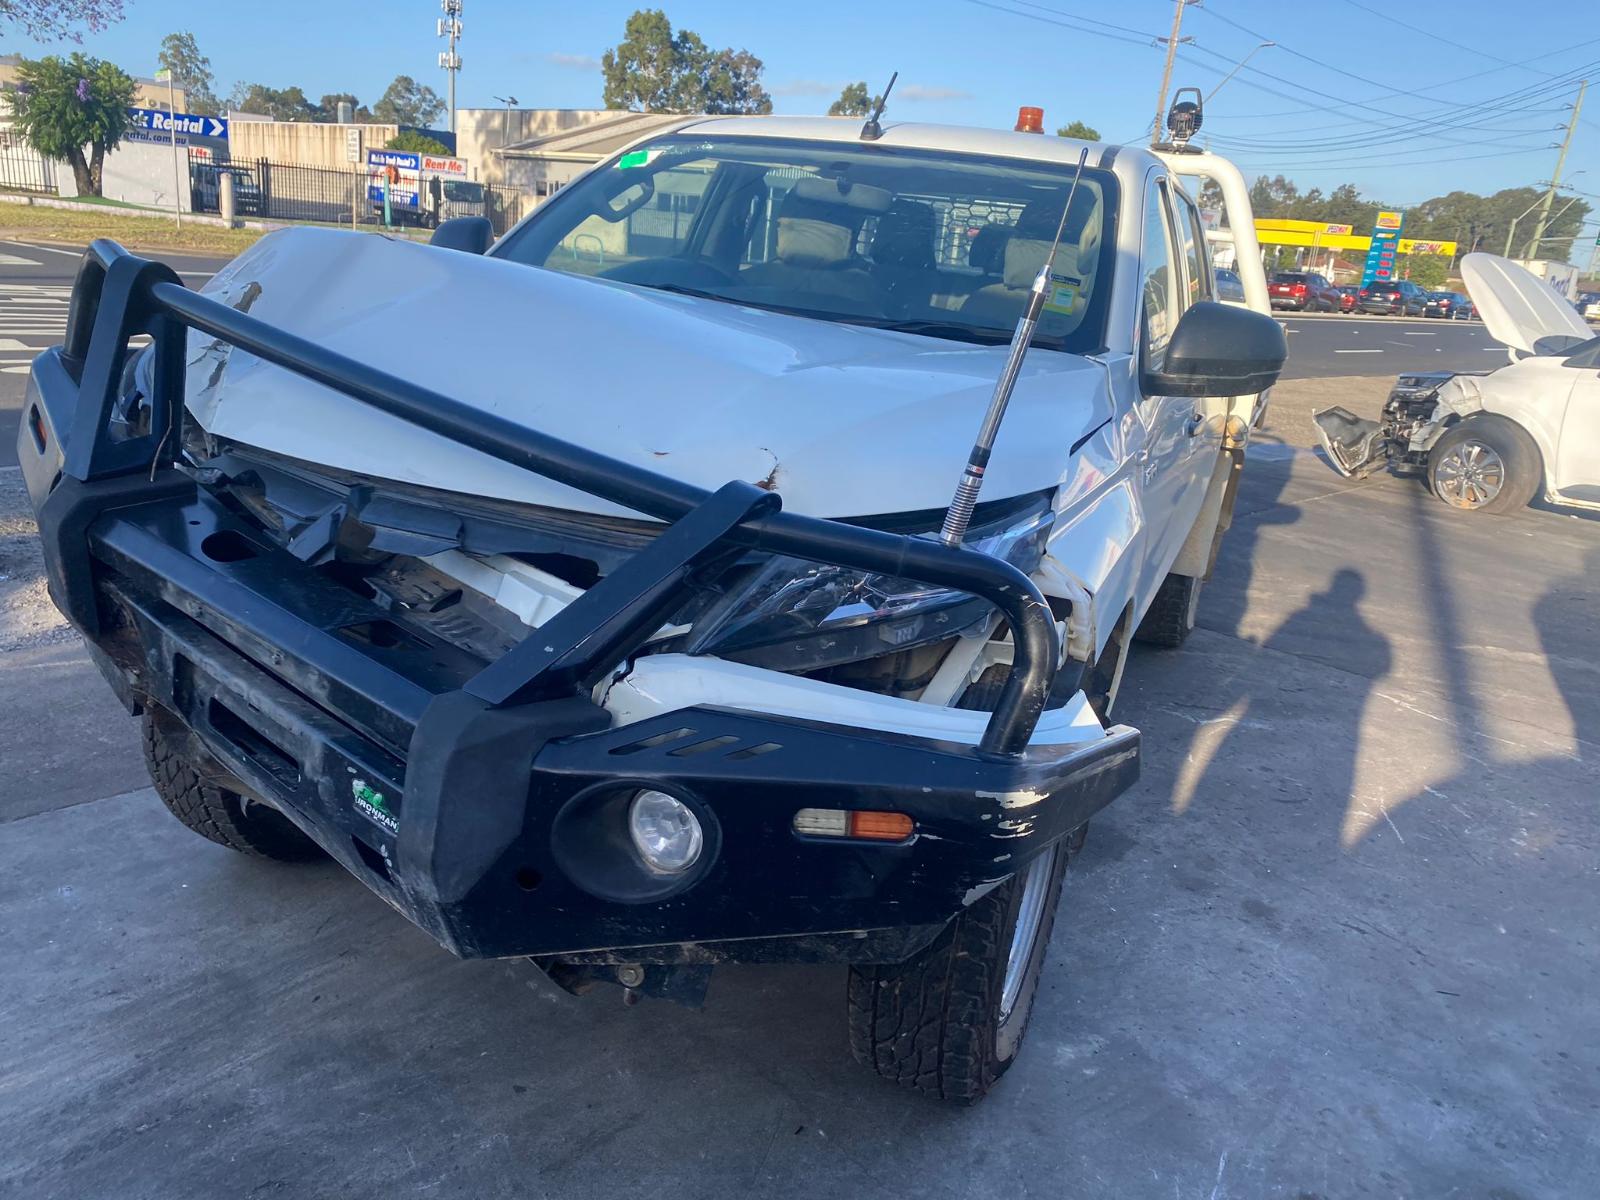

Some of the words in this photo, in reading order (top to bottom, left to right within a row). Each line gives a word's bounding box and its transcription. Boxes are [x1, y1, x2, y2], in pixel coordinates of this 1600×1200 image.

[152, 113, 204, 133] Rental
[424, 158, 446, 170] Rent
[447, 161, 463, 172] Me
[357, 798, 397, 829] IRONMAN
